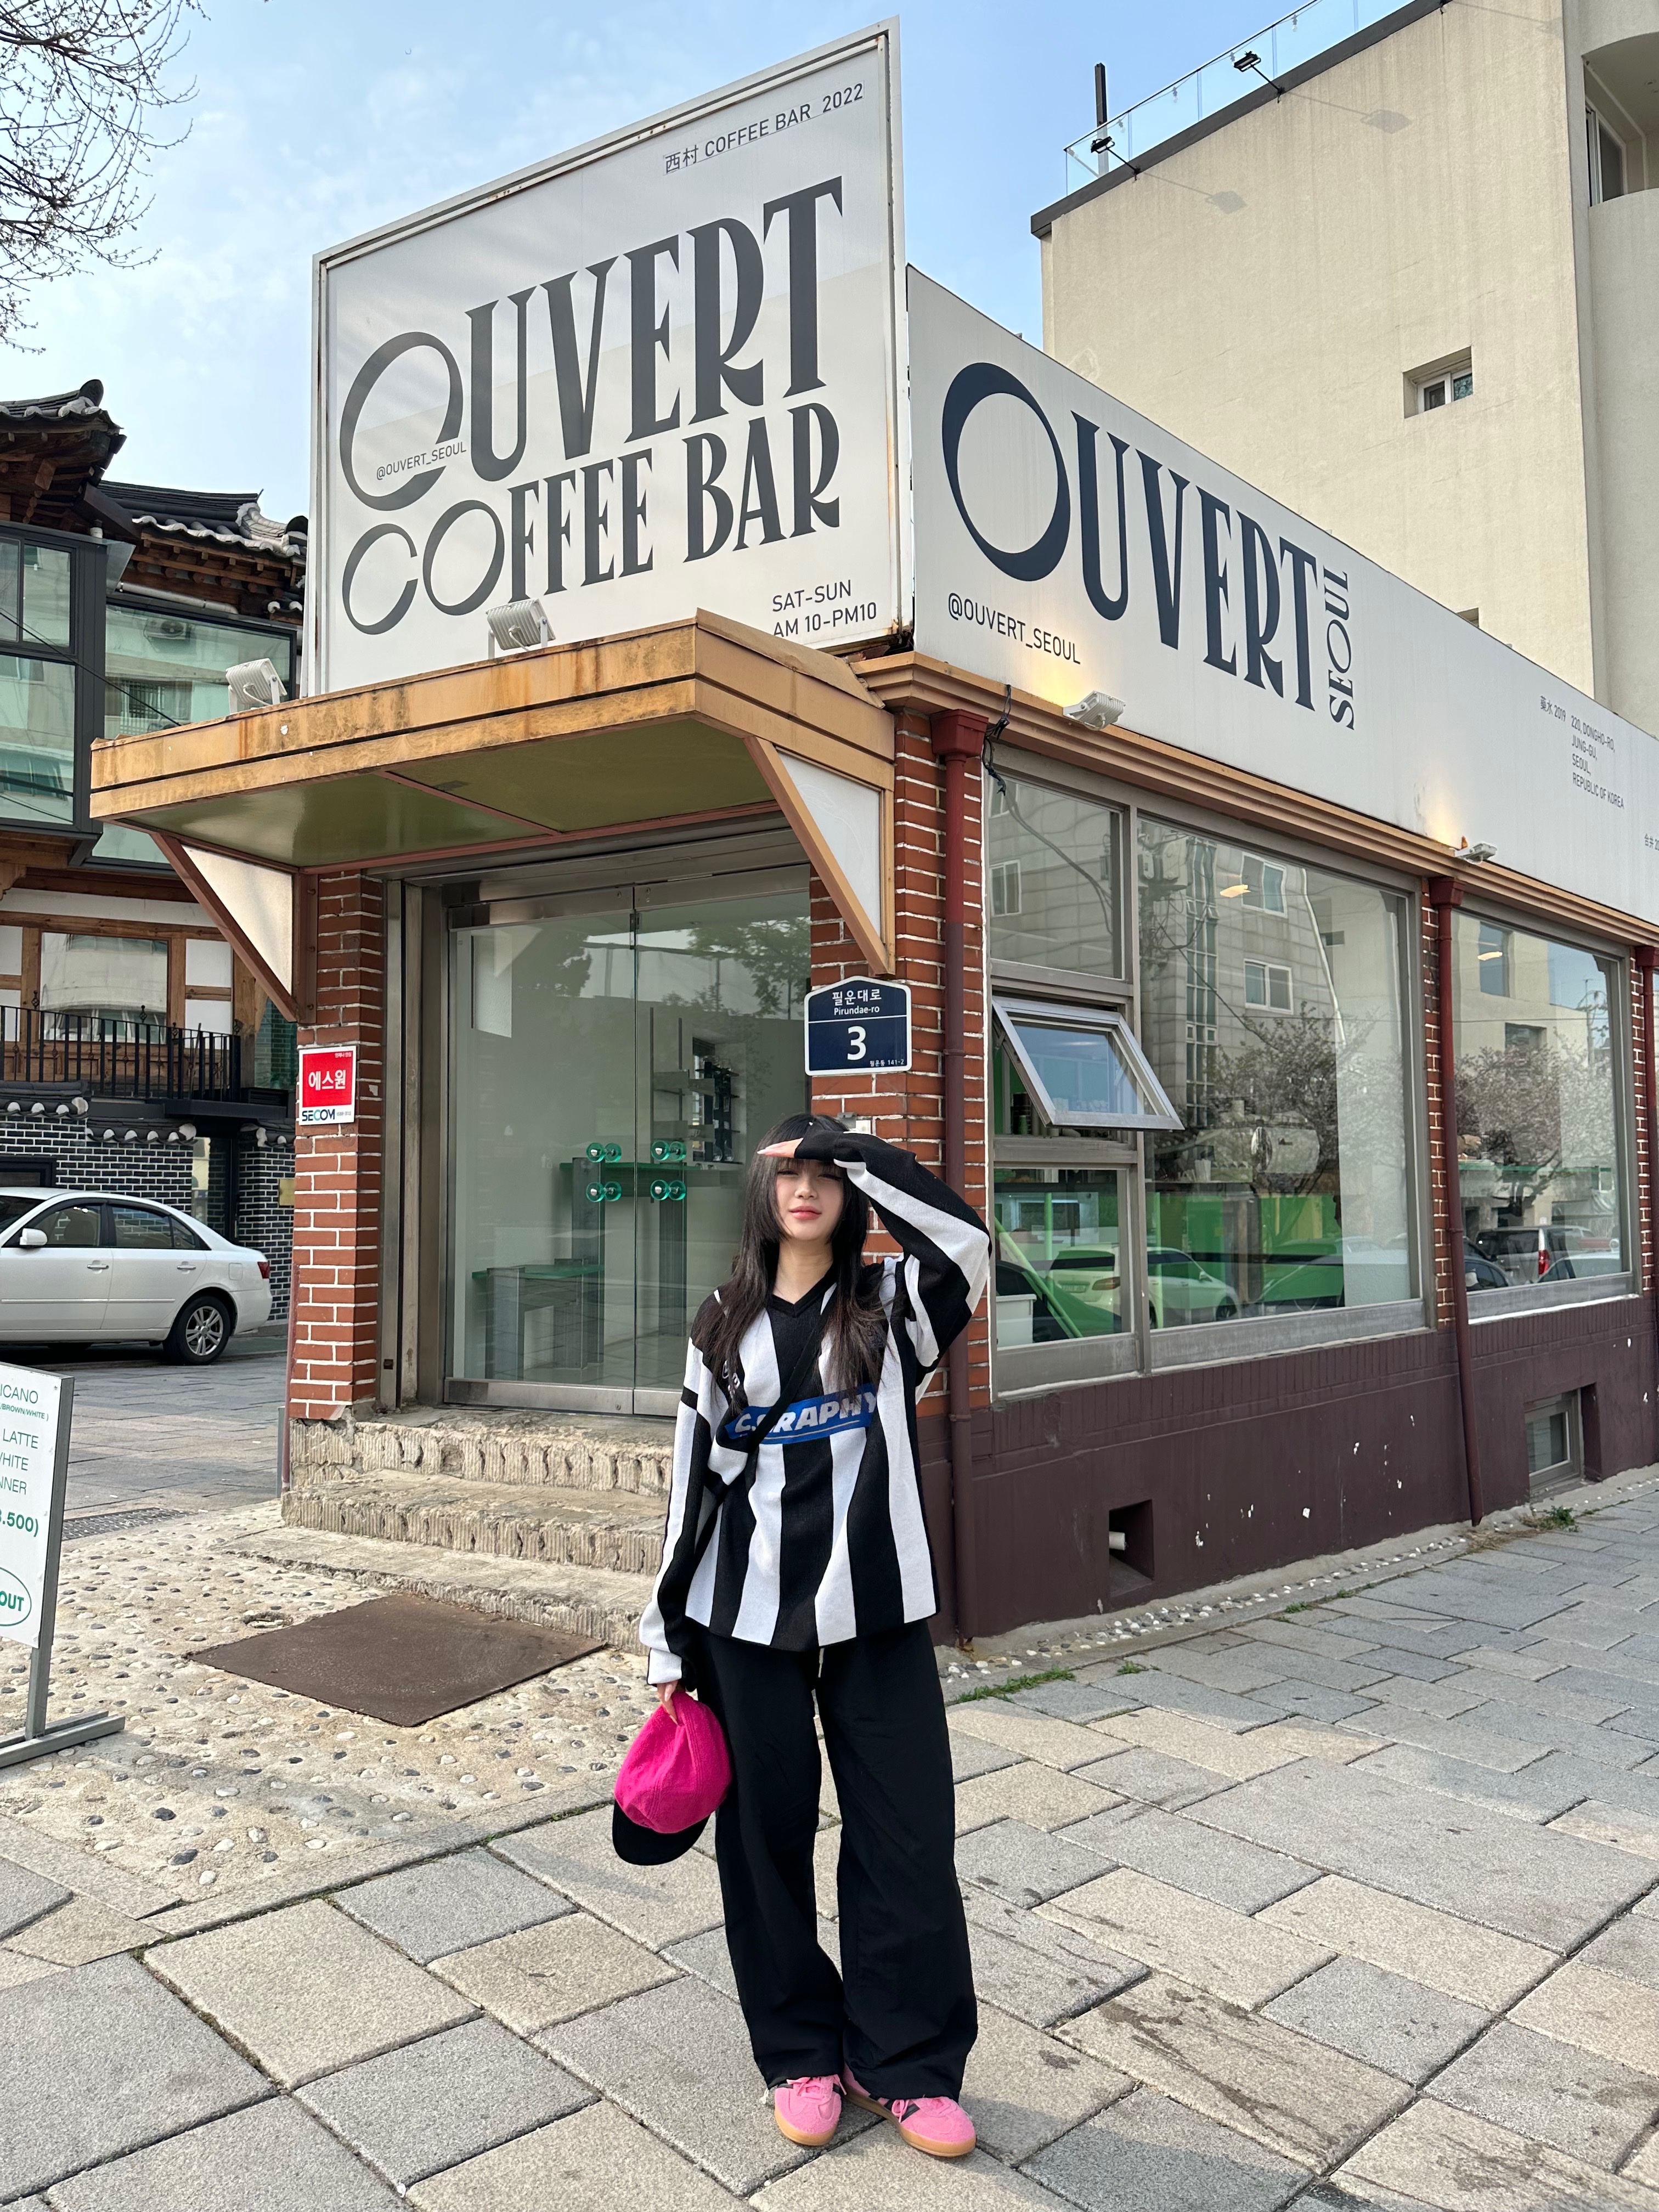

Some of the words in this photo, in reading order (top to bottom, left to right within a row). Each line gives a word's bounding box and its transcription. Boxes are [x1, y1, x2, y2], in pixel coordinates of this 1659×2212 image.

[665, 145, 698, 174] 西村
[705, 119, 769, 157] COFFEE
[775, 104, 811, 129] BAR
[822, 83, 863, 112] 2022
[339, 176, 842, 511] OUVERT
[376, 441, 467, 480] @OUVERT_SEOUL
[342, 448, 653, 635] COFFEE
[682, 402, 839, 563] BAR
[942, 362, 1318, 712] OUVERT
[772, 579, 851, 612] SAT-SUN
[774, 618, 798, 637] AM
[805, 602, 877, 632] 10-PM10
[948, 592, 1081, 665] @OUVERT_SEOUL
[1323, 565, 1355, 730] SEOUL
[1554, 704, 1566, 722] 2019
[1571, 715, 1582, 734] 220,
[1583, 722, 1616, 753] DONGHO-RO,
[1572, 735, 1598, 761] JUNG-GU,
[1572, 753, 1592, 776] SEOUL,
[1572, 772, 1599, 797] REPUBLIC
[1600, 787, 1606, 800] OF
[1607, 790, 1624, 810] KOREA
[832, 989, 882, 1006] 필운대로
[834, 1005, 880, 1015] Pirundae-ro
[847, 1025, 867, 1060] 3
[308, 1069, 346, 1091] 에스원
[302, 1109, 335, 1121] SECOM
[3, 1428, 39, 1449] LATTE
[0, 1509, 39, 1537] .500)
[0, 1590, 25, 1612] OUT
